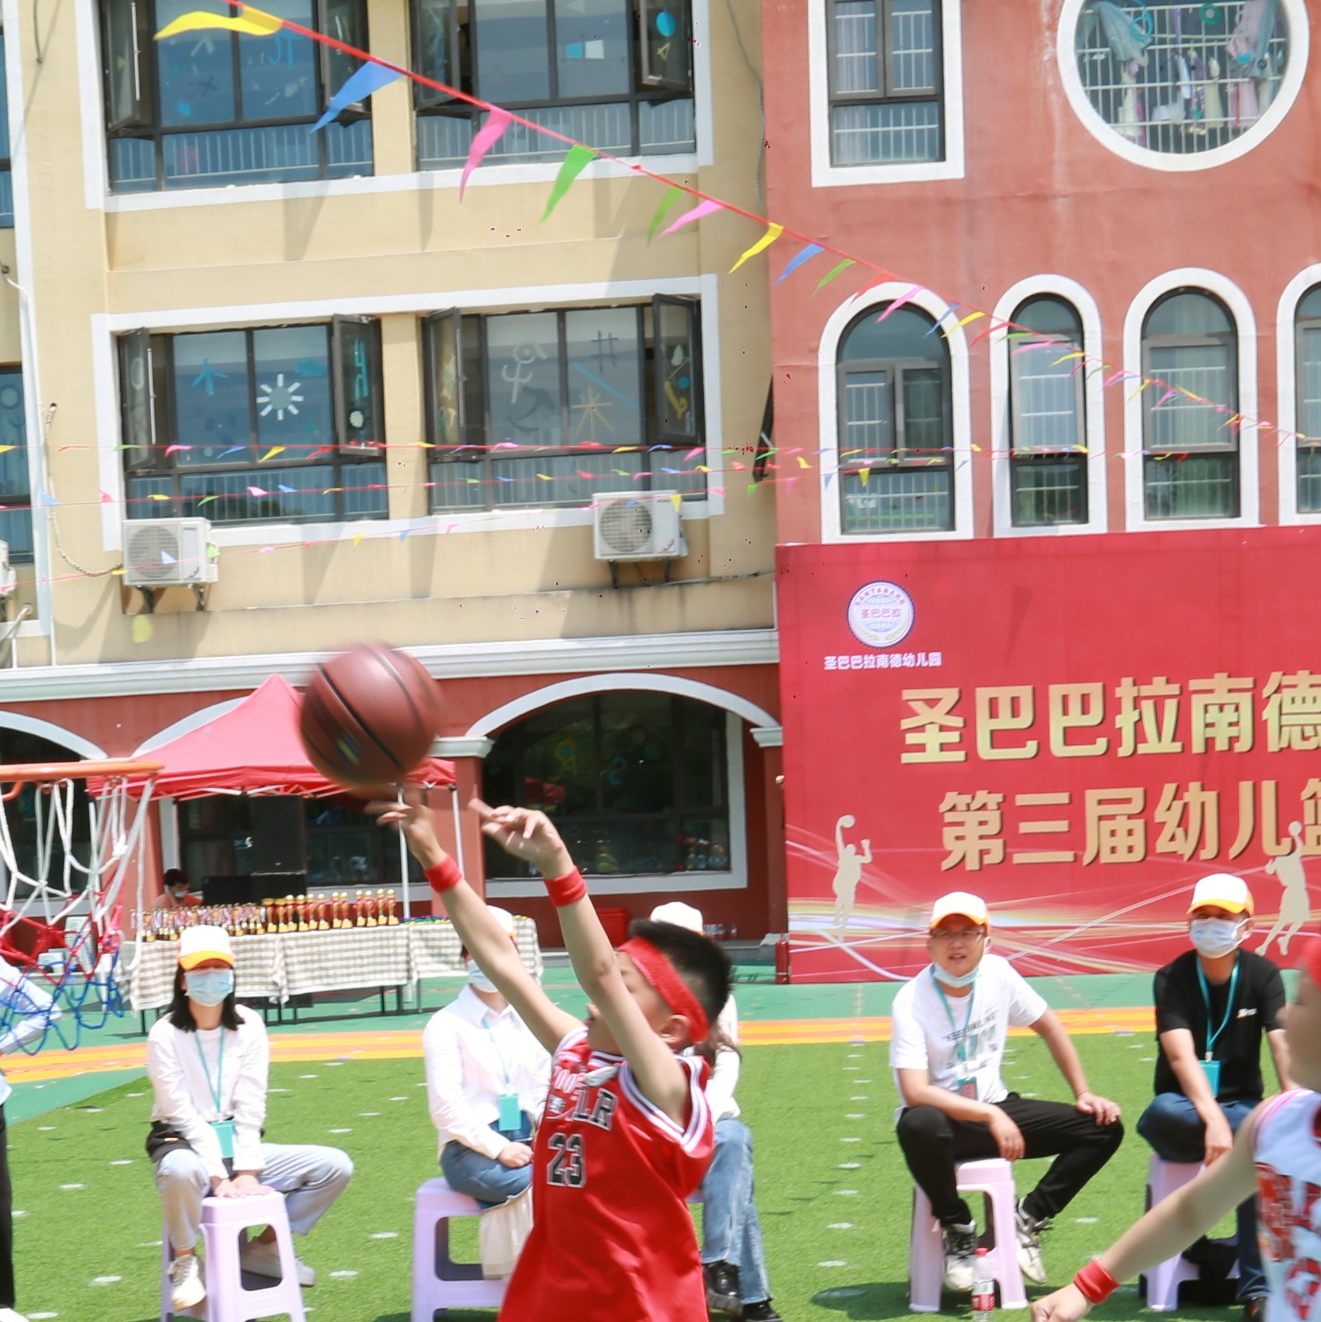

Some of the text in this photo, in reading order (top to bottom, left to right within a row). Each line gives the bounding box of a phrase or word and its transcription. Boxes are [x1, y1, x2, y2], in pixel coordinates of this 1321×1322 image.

[861, 608, 901, 619] 圣巴巴拉
[824, 652, 942, 670] 圣巴巴拉南德幼儿园
[546, 1131, 587, 1188] 23
